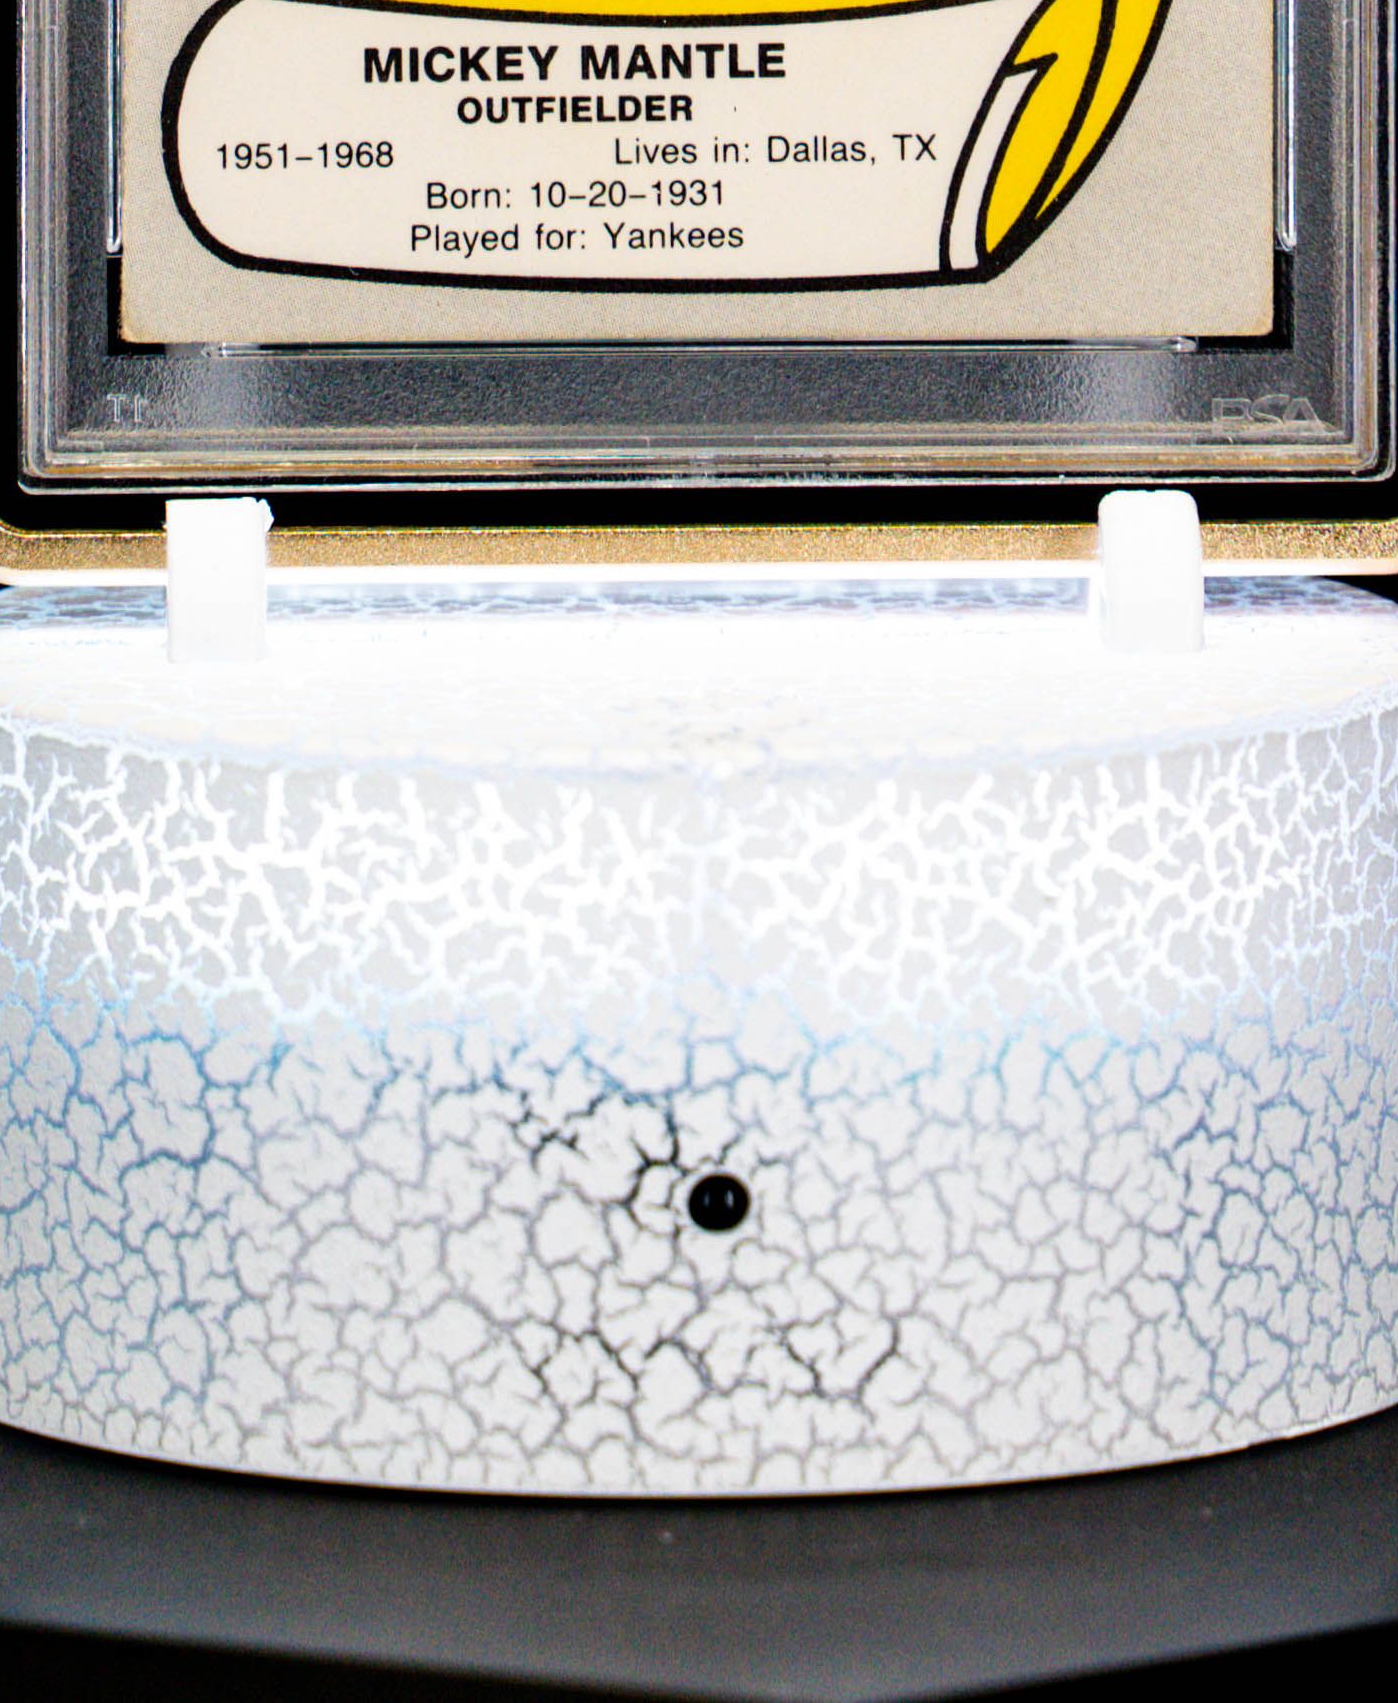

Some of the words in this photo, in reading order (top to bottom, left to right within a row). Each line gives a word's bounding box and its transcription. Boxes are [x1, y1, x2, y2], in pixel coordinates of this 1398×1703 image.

[363, 44, 560, 84] MICKEY
[580, 42, 787, 81] MANTLE
[456, 94, 693, 126] OUTFIELDER
[614, 137, 698, 166] Lives
[713, 136, 750, 164] in:
[767, 134, 876, 166] Dallas,
[891, 133, 937, 162] TX
[426, 181, 511, 211] Born:
[410, 223, 520, 257] Played
[534, 222, 586, 251] for:
[602, 221, 745, 250] Yankees
